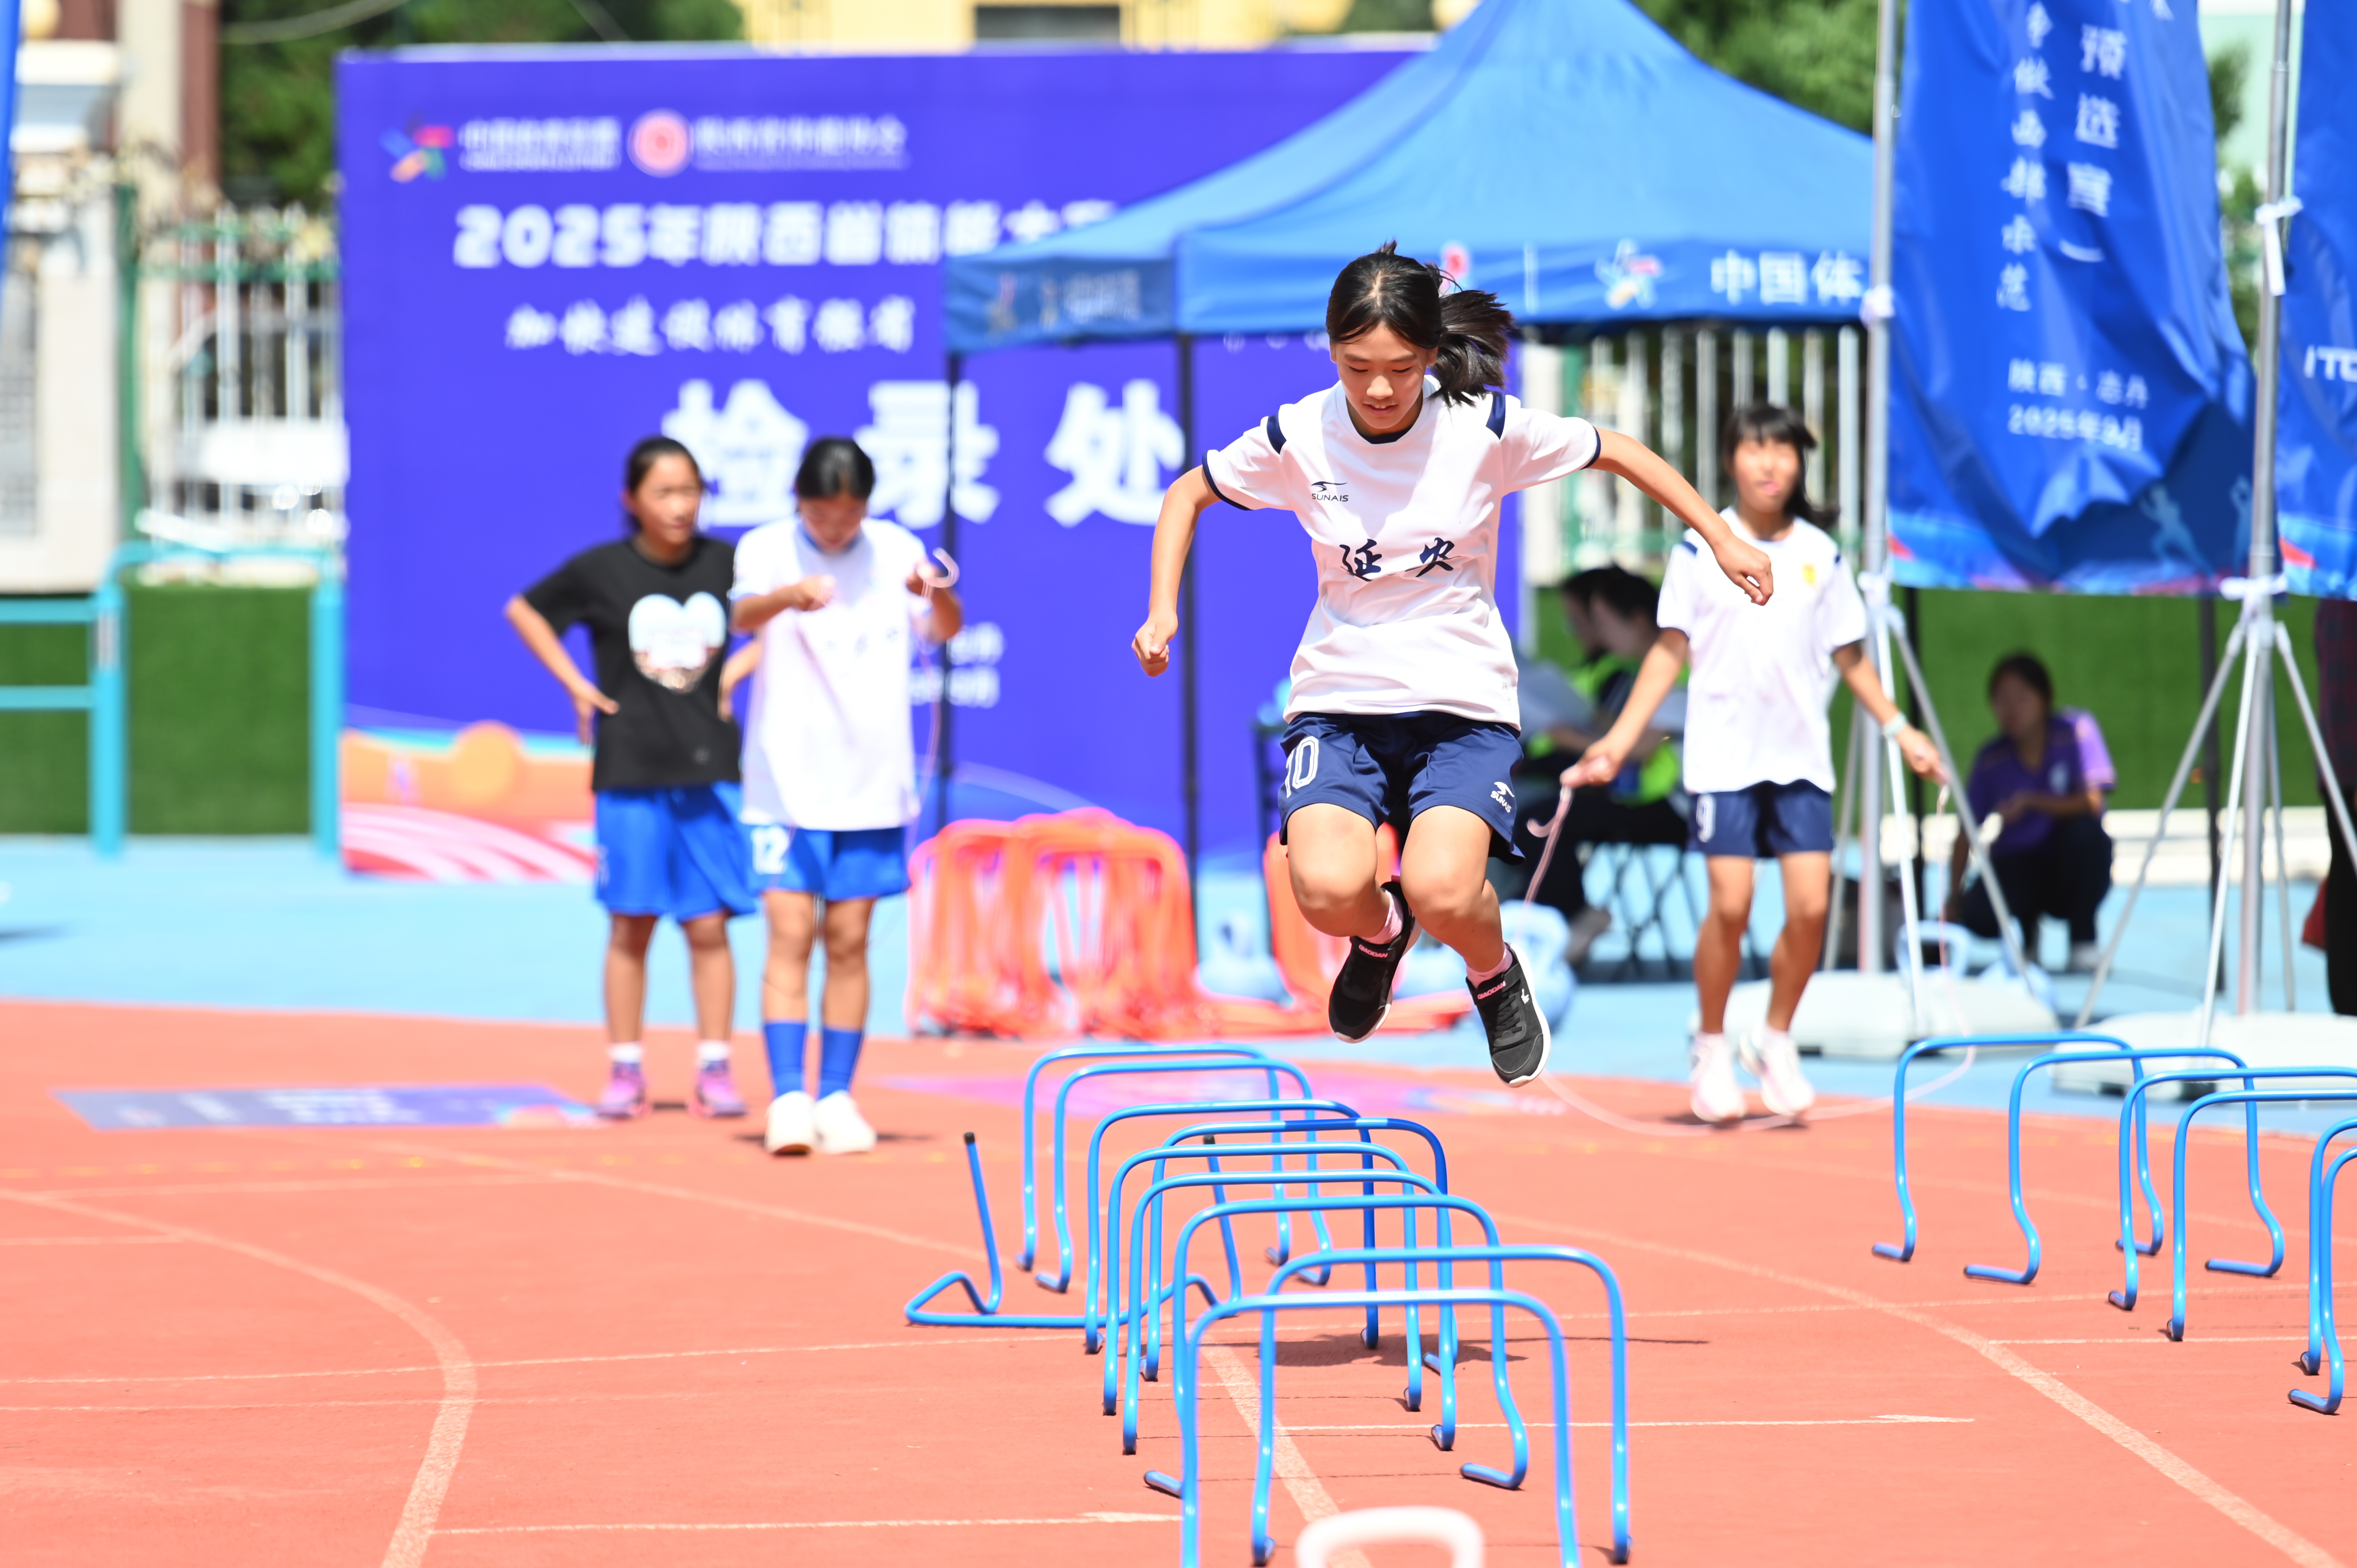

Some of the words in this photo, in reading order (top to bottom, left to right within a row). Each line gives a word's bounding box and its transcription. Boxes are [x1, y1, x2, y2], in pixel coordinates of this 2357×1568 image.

[1312, 493, 1349, 502] SUNAIS
[1491, 790, 1512, 813] SUNAIS
[1696, 794, 1716, 843] 9
[750, 826, 789, 875] 12
